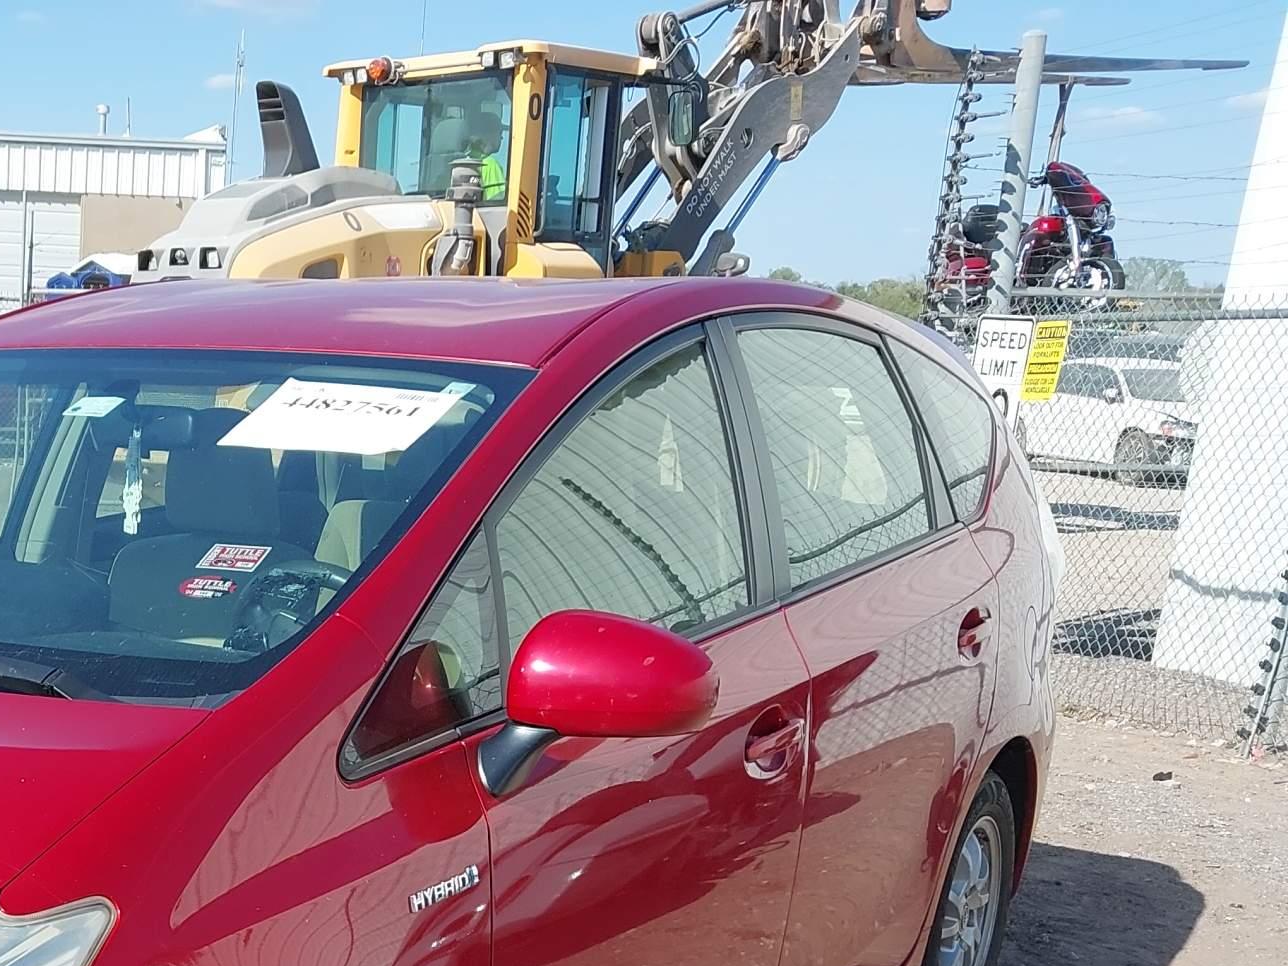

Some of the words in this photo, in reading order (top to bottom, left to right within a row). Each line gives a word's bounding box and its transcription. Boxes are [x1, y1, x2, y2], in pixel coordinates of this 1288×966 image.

[686, 195, 699, 214] DO
[697, 168, 714, 196] NOT
[712, 138, 734, 169] WALK
[695, 180, 720, 217] UNDER
[718, 150, 737, 181] MAST
[980, 331, 1027, 350] SPEED
[1038, 326, 1067, 338] CAUTION
[980, 358, 1018, 378] LIMIT
[282, 396, 422, 417] 44827561
[223, 547, 265, 557] TUTTLE
[192, 578, 233, 587] TUTTLE
[409, 871, 469, 912] HYBRID
